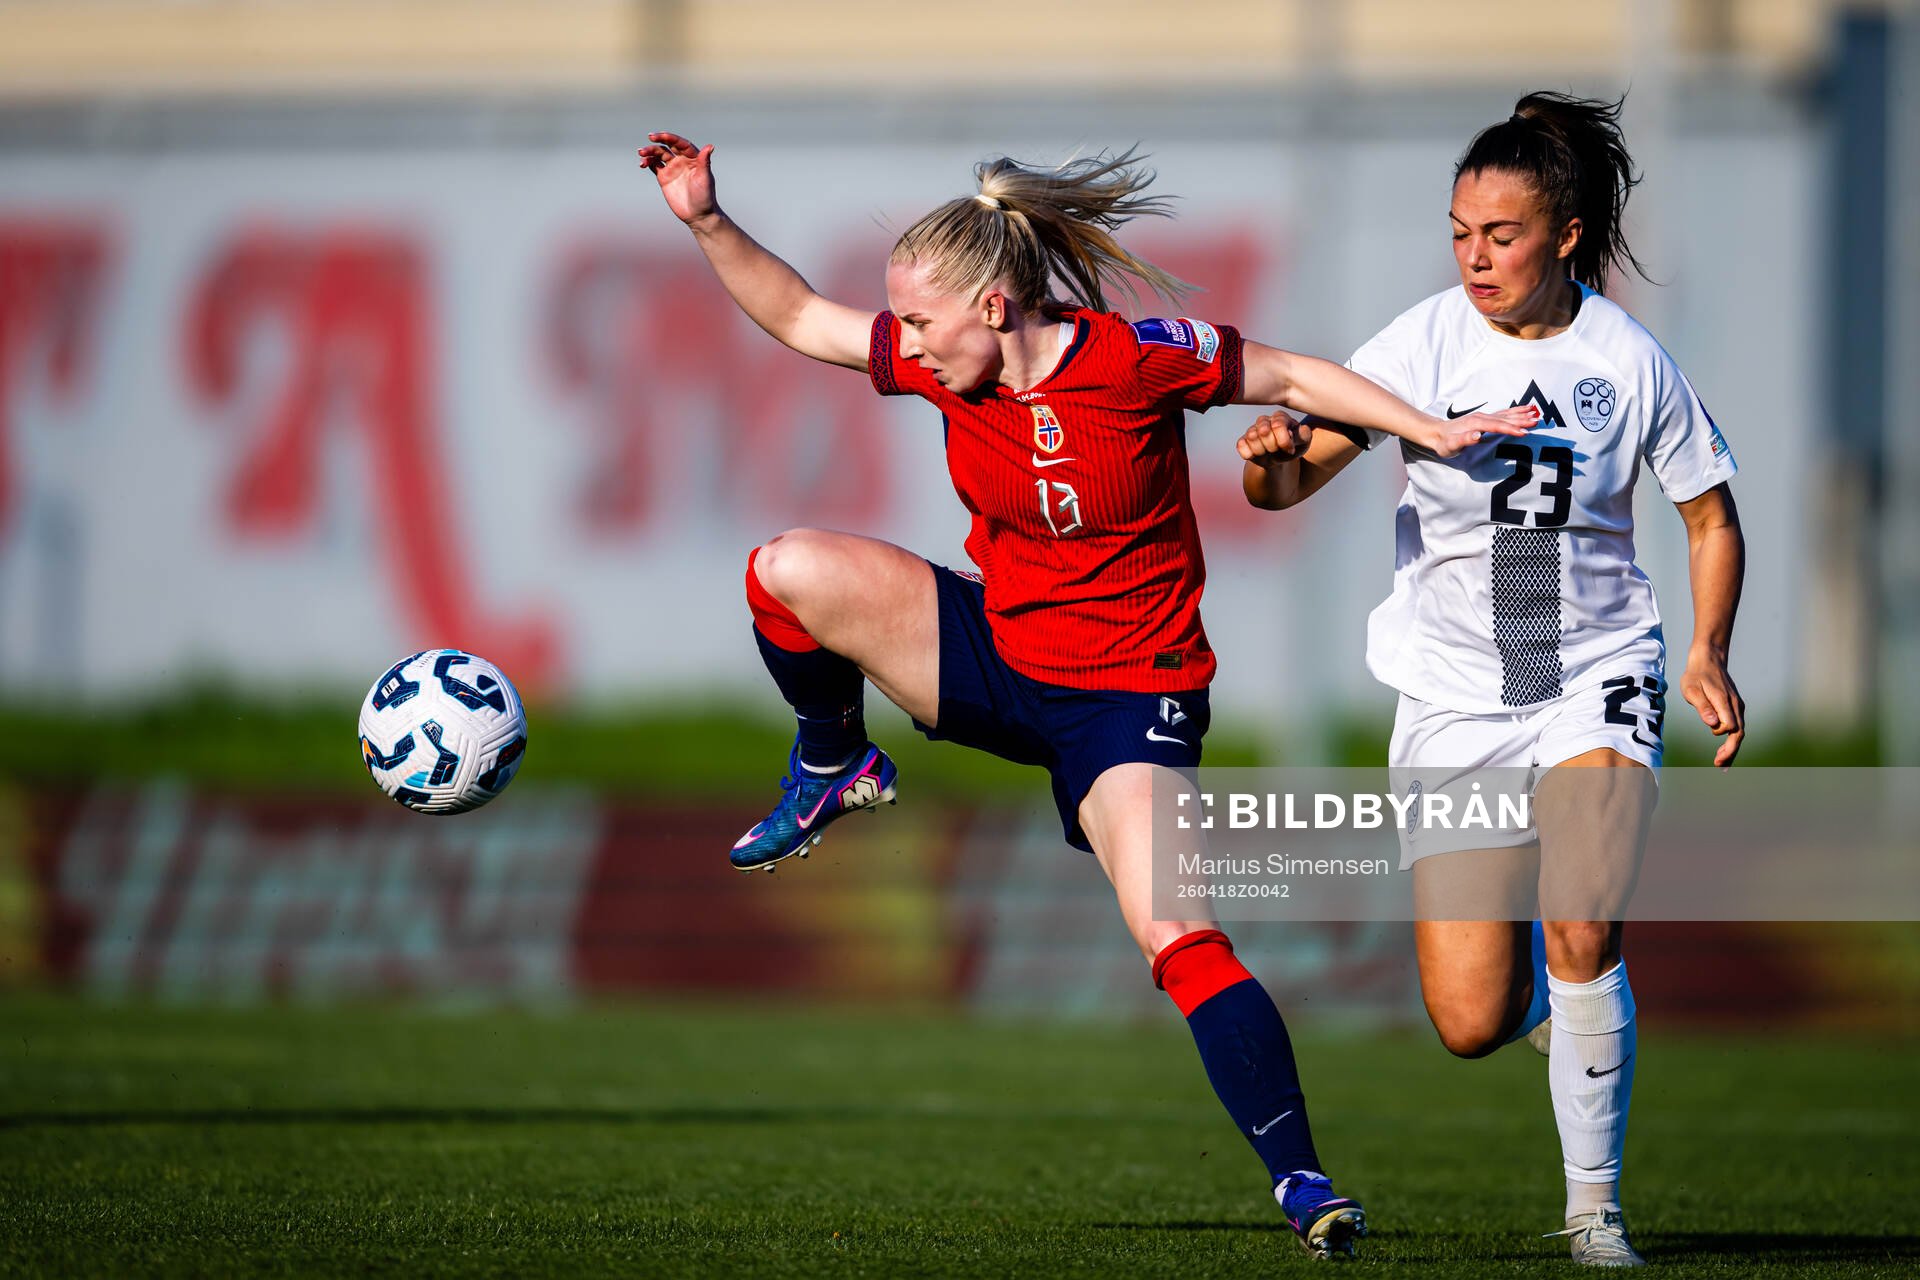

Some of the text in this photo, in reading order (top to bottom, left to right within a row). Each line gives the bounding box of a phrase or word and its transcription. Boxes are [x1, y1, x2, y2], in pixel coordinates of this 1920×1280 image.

[1034, 478, 1083, 538] 13
[1490, 443, 1574, 527] 23
[1601, 674, 1666, 740] 23
